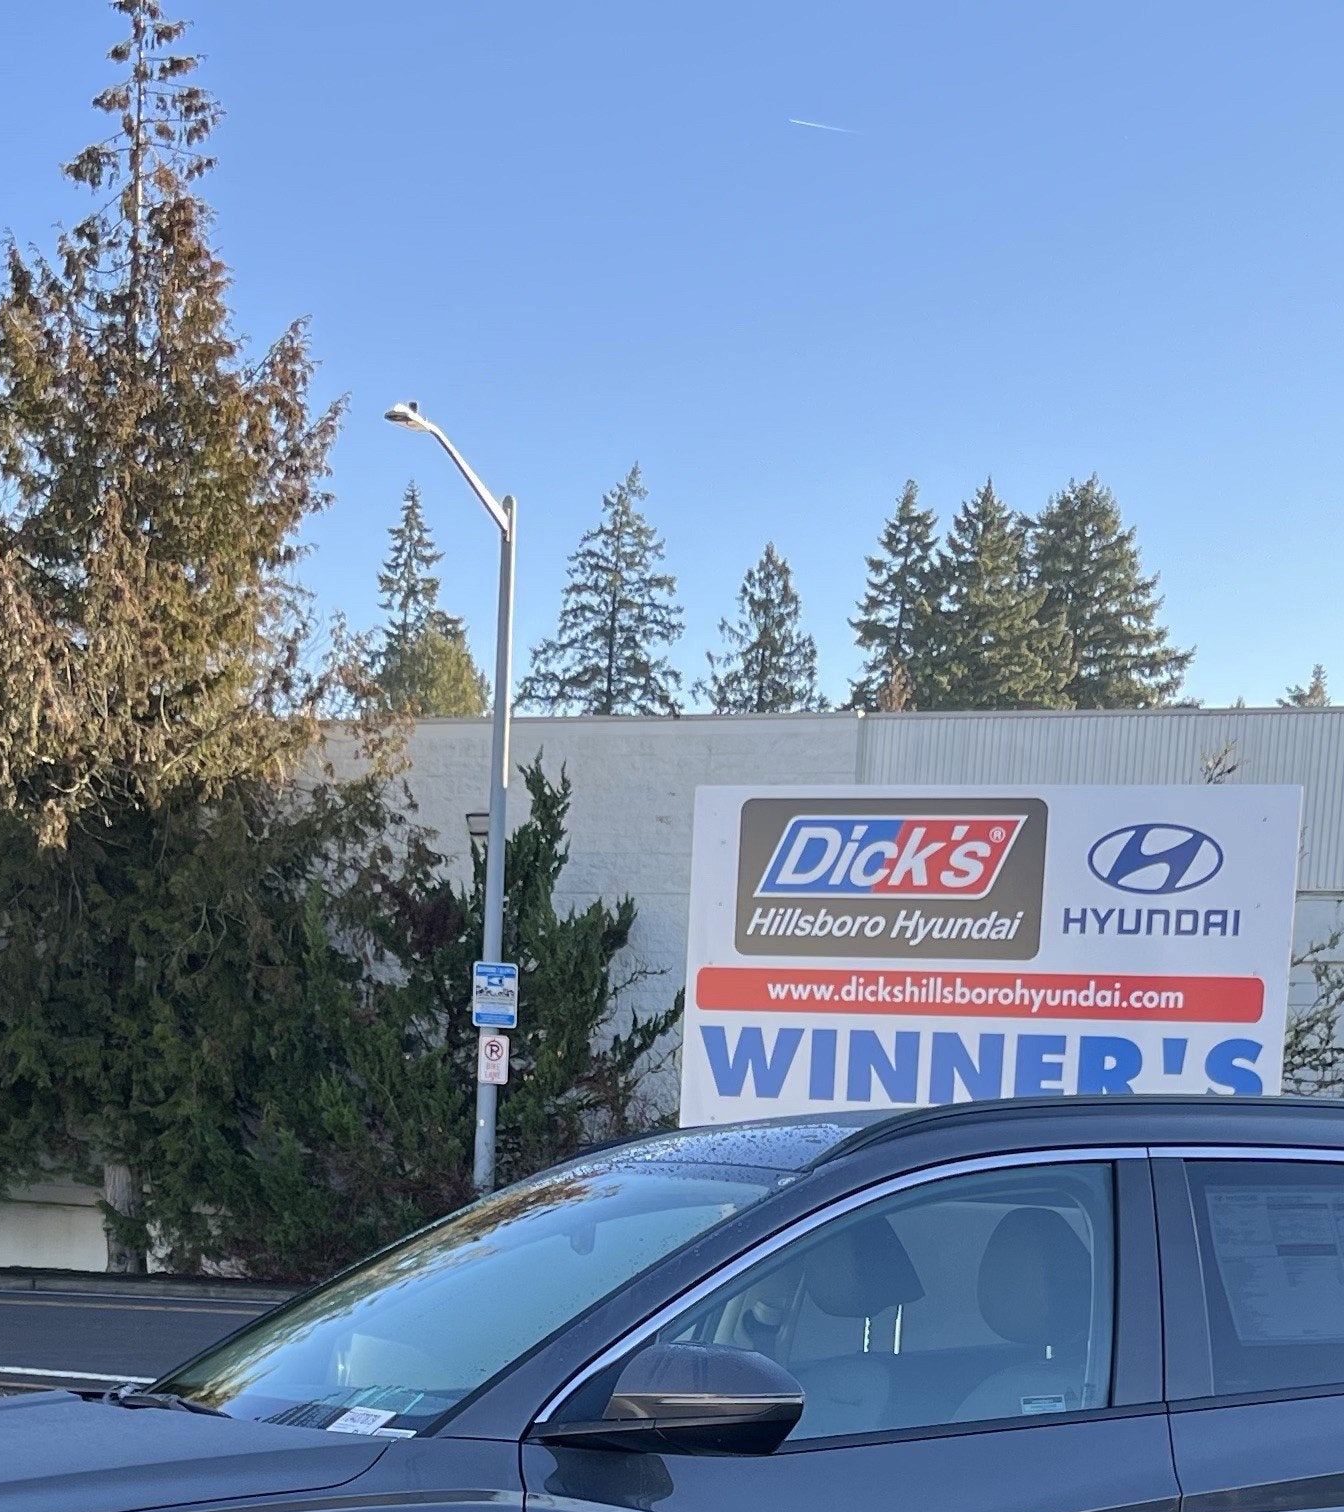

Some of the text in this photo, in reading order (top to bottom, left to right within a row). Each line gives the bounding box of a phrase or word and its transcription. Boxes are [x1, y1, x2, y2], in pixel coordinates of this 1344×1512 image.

[746, 907, 1024, 946] Hillsboro Hyundai
[1062, 907, 1241, 937] HYUNDAI
[767, 977, 1184, 1013] www.dickshillsborohyundai.com
[700, 1025, 1264, 1104] WINNER'S
